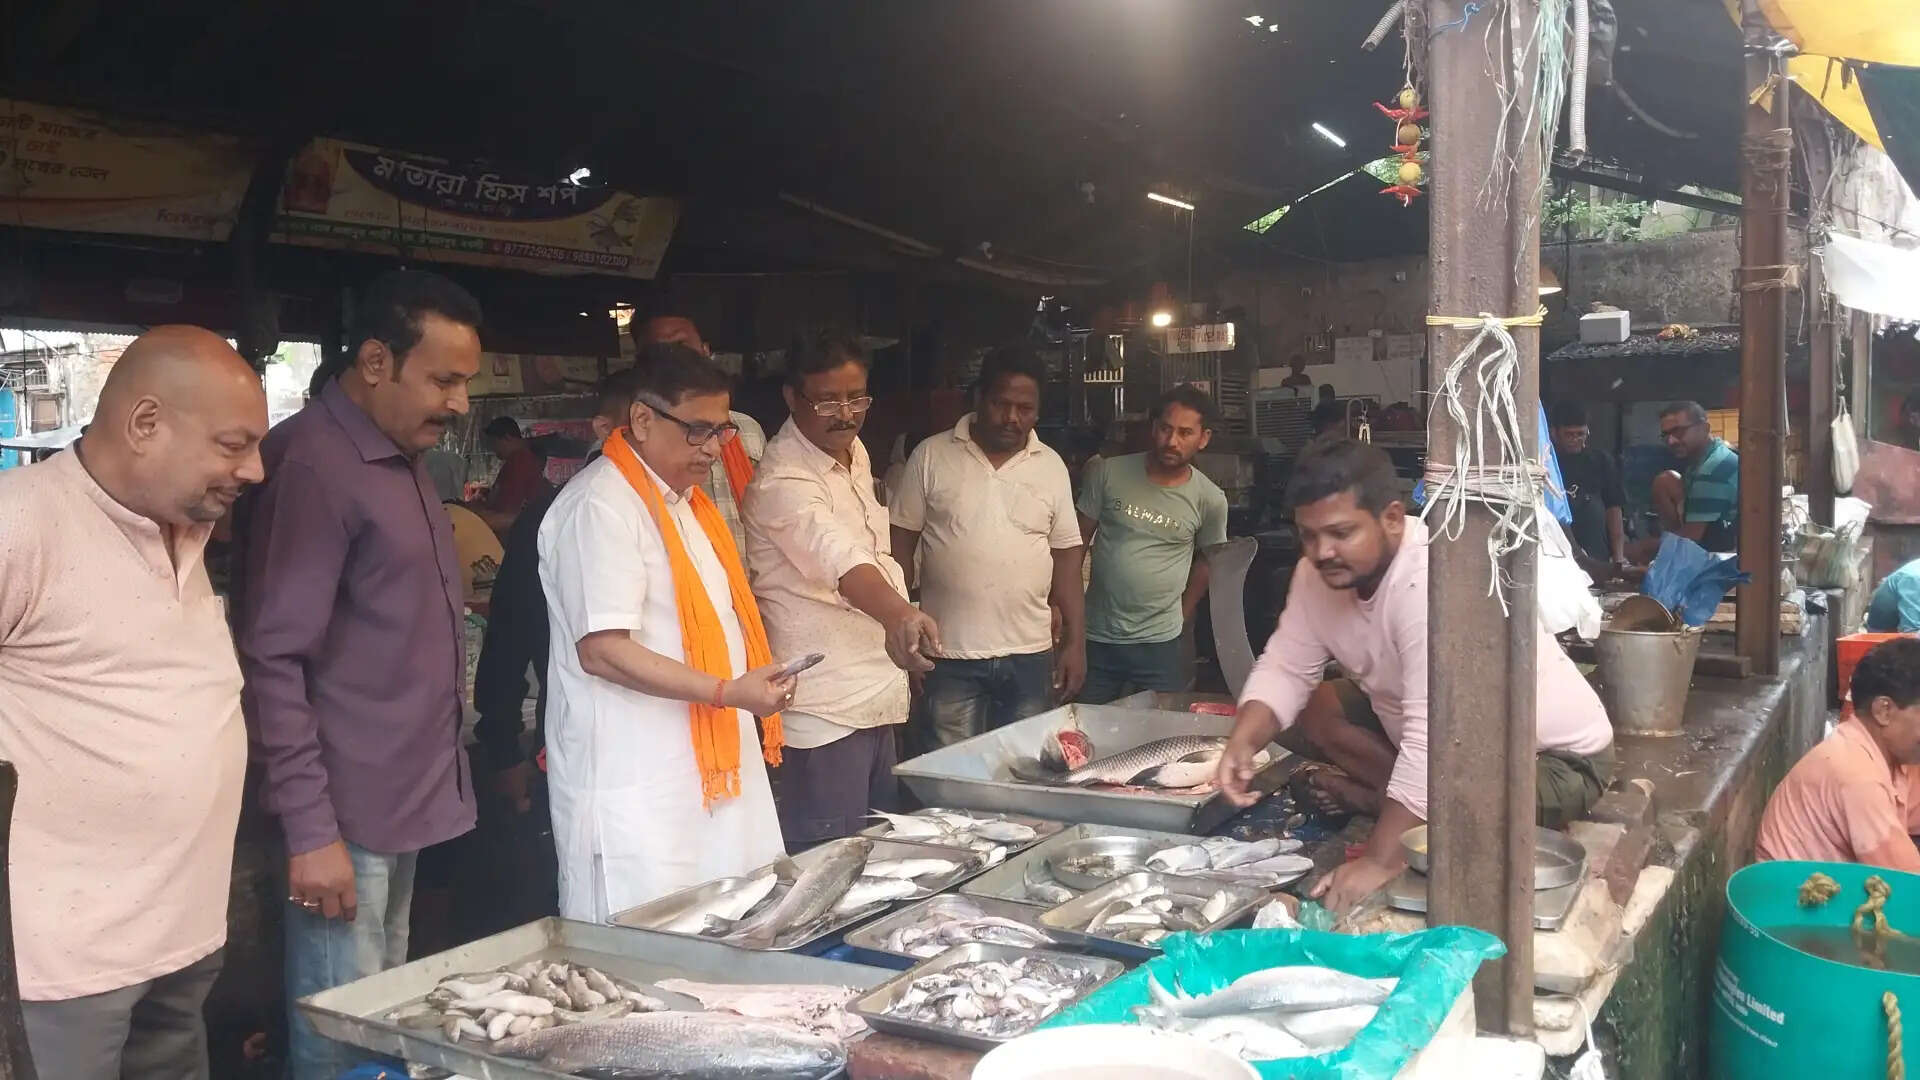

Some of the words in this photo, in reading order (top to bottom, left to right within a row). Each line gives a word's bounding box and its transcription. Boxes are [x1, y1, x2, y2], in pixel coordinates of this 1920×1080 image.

[475, 174, 529, 204] ফিস
[536, 184, 577, 205] শপ
[1747, 993, 1785, 1025] Limited
